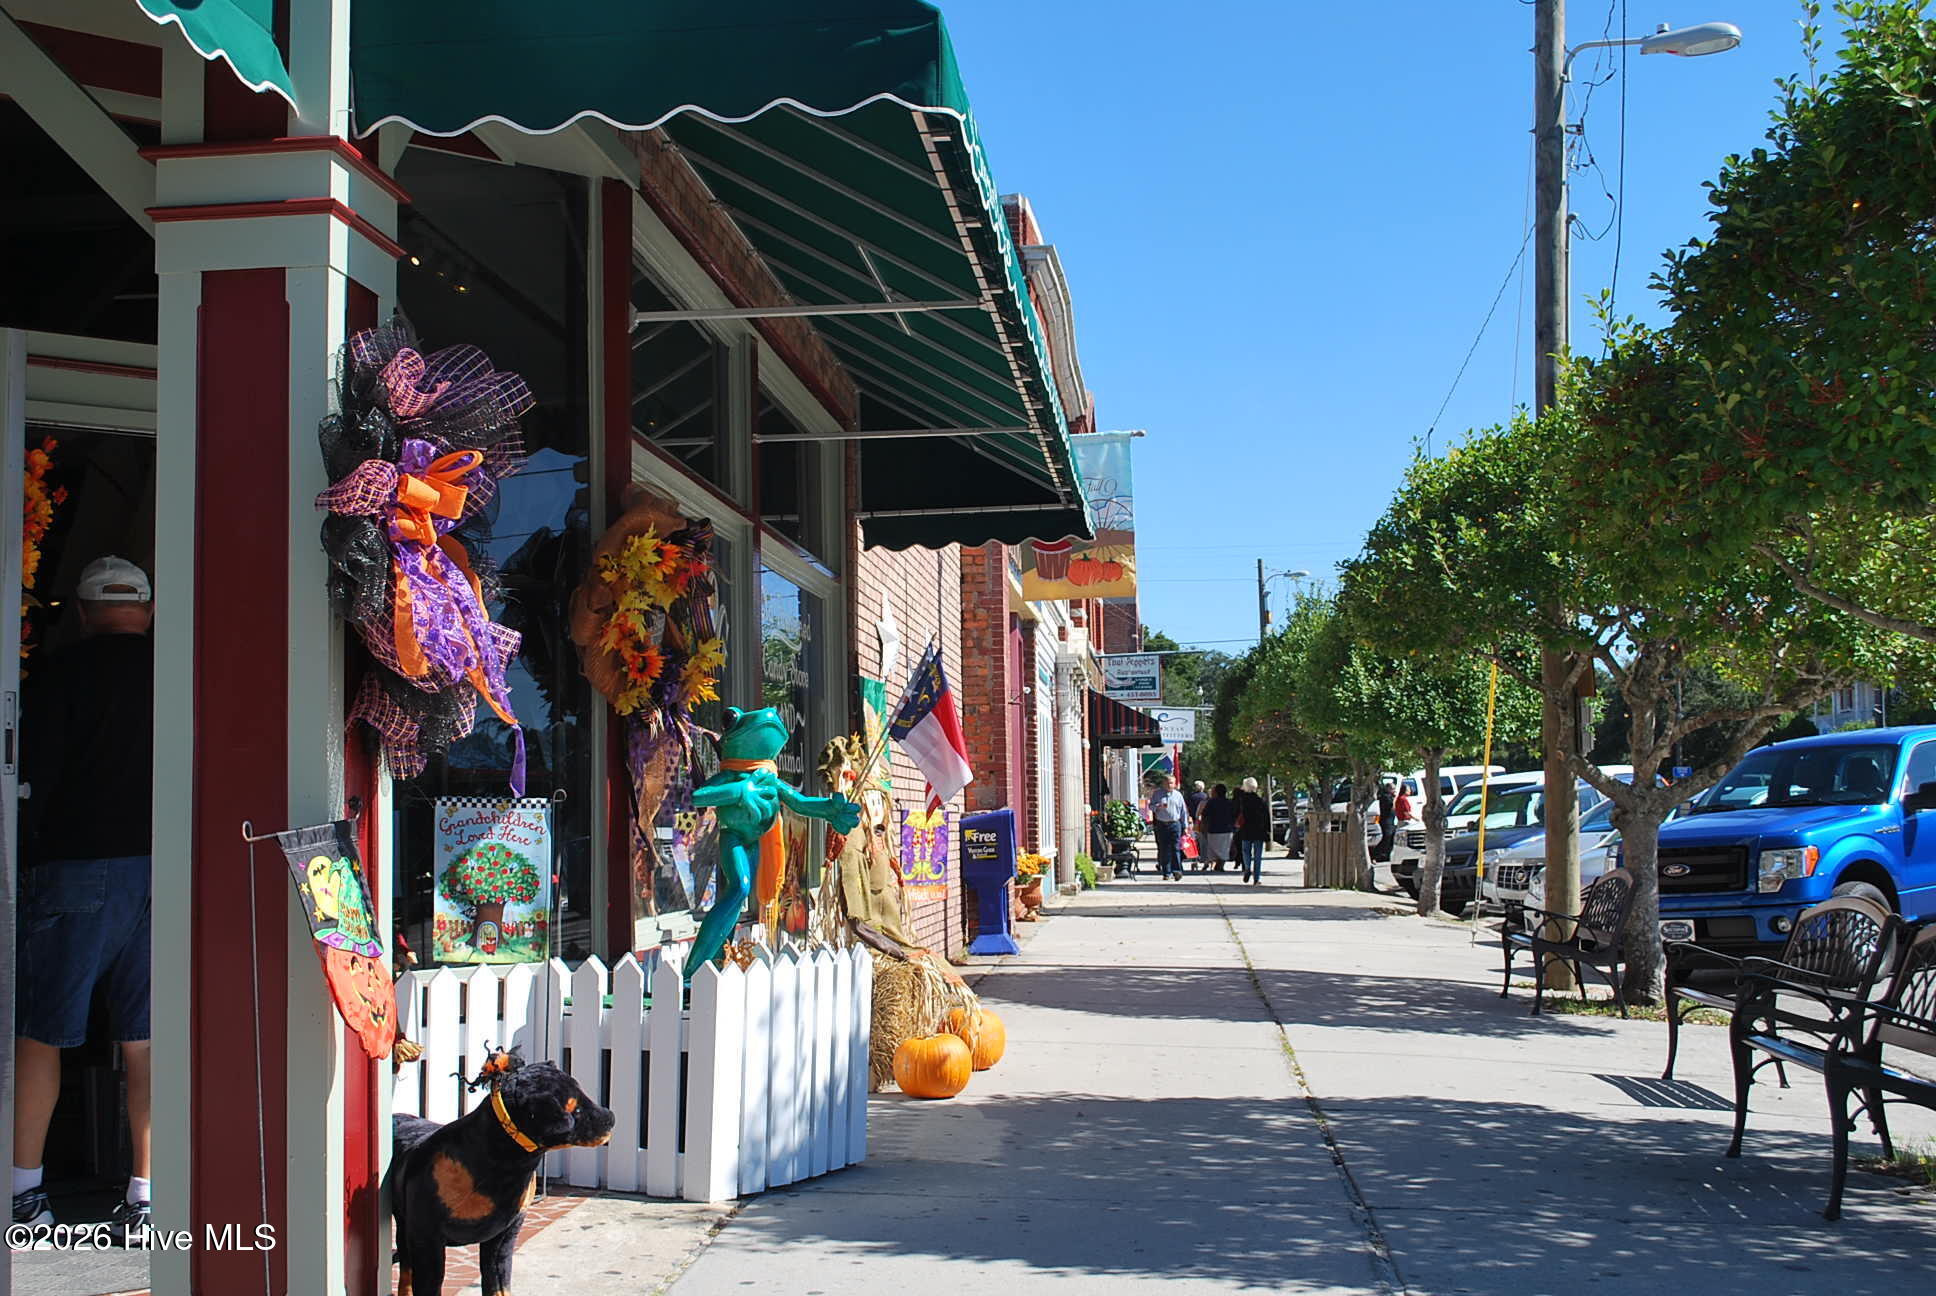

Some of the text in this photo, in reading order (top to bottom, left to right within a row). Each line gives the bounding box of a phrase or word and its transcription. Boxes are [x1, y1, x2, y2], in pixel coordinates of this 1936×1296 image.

[777, 742, 805, 775] nimal
[439, 810, 547, 836] Grandchildren
[456, 825, 532, 846] Loved Here
[972, 831, 997, 843] Free
